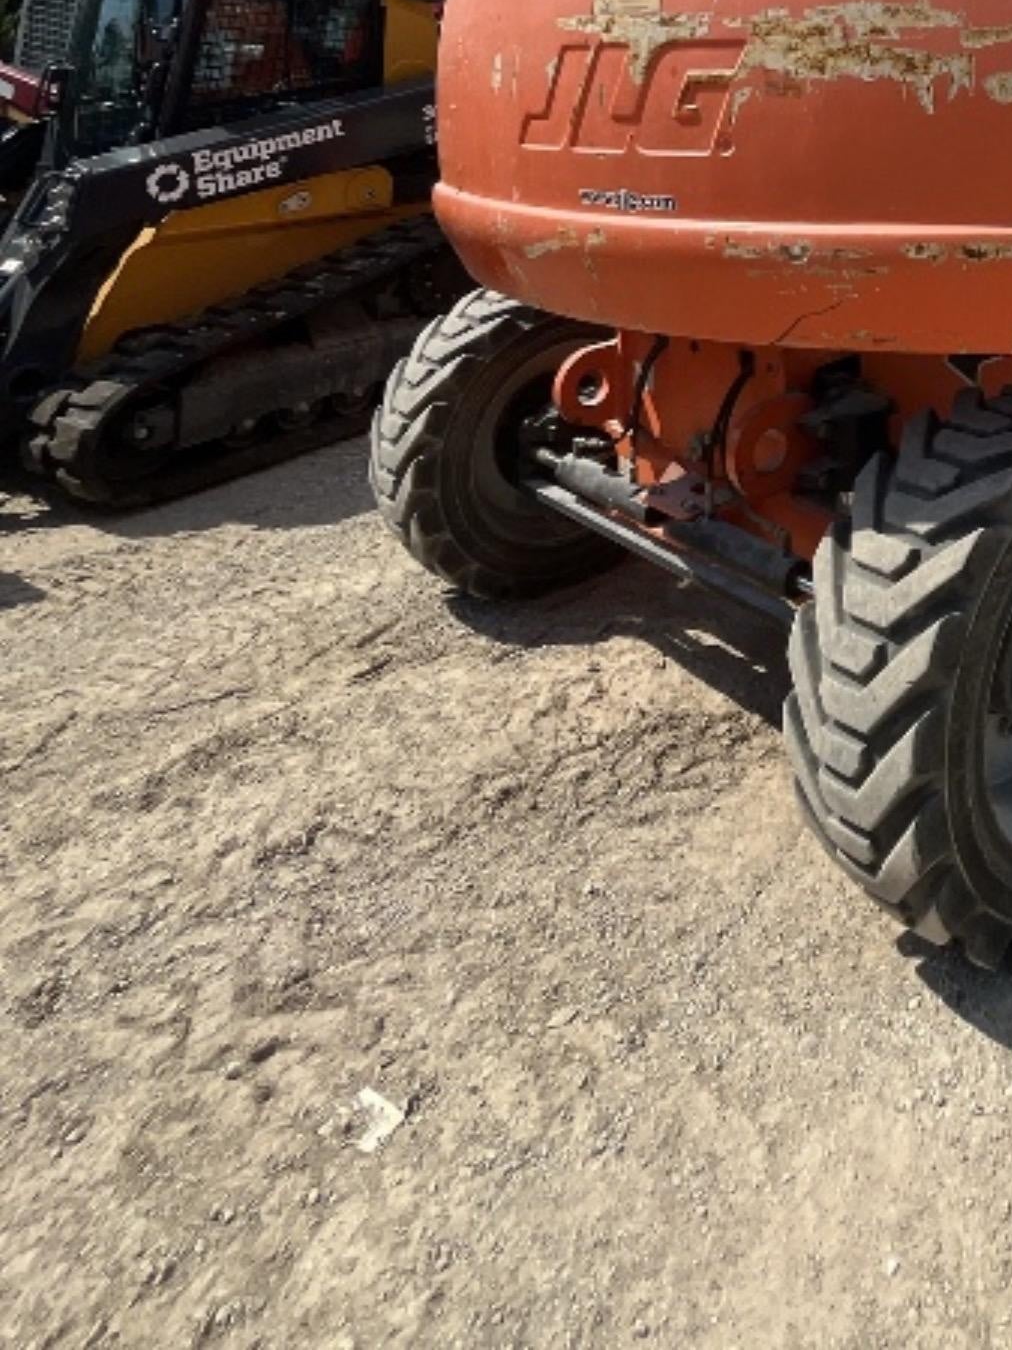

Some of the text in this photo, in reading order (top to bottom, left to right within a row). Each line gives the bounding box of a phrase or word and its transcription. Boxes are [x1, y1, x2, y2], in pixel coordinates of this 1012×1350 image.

[519, 38, 748, 157] JLG
[191, 119, 346, 174] Equipment
[196, 162, 283, 199] Share
